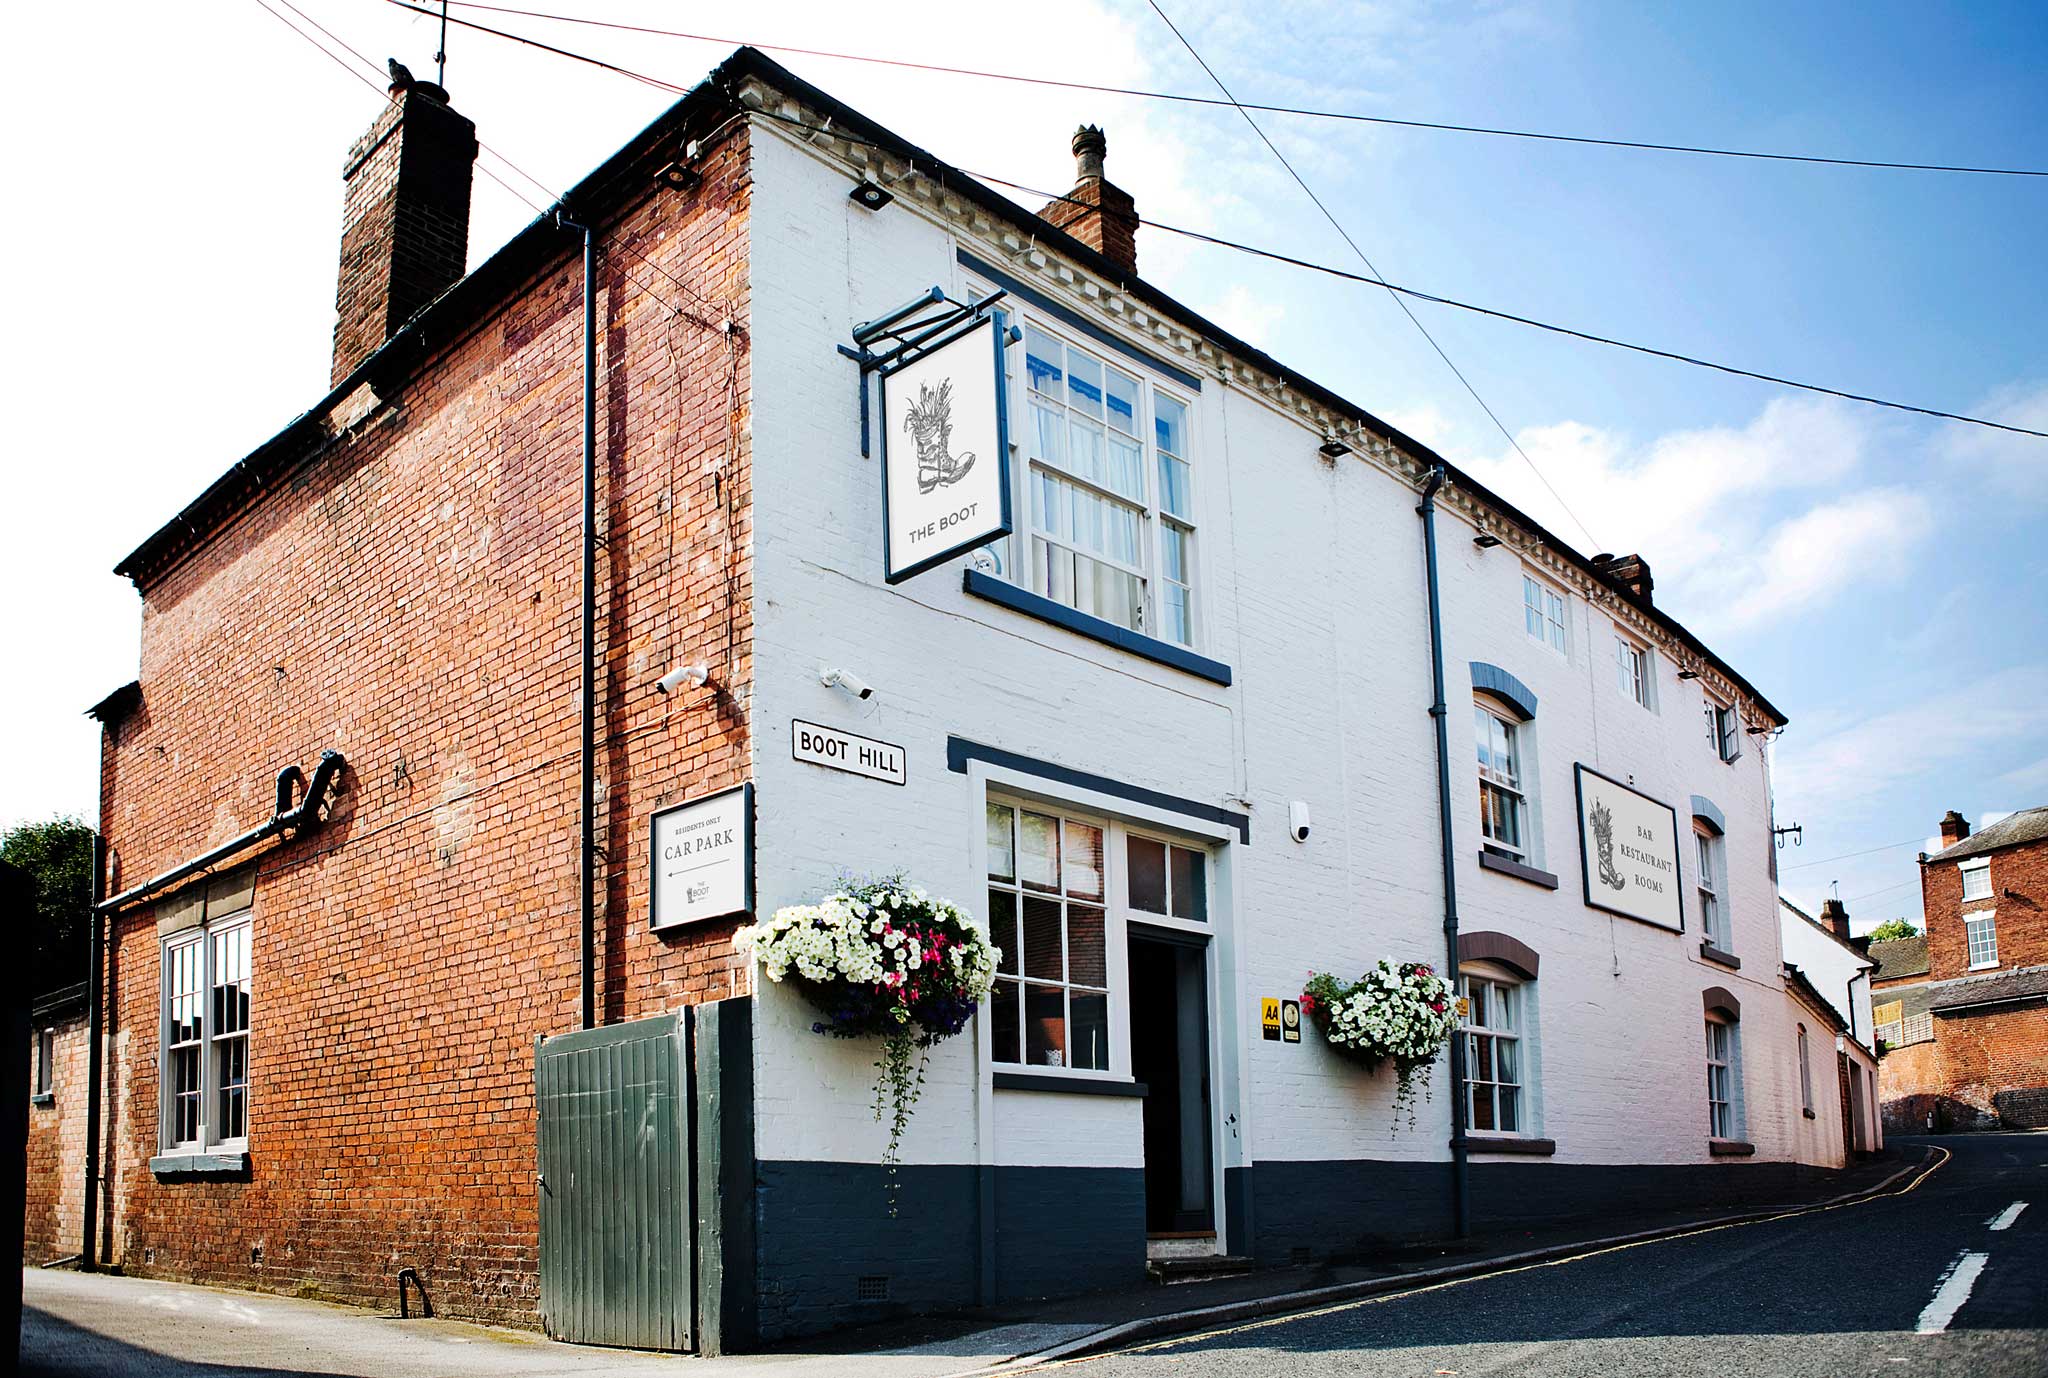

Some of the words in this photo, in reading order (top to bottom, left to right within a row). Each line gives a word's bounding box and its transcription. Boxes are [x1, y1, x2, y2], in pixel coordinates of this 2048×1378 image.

[909, 522, 935, 543] THE
[940, 502, 978, 531] BOOT
[801, 731, 848, 760] BOOT
[860, 746, 898, 773] HILL
[675, 821, 705, 835] RESIDENTS
[705, 816, 721, 827] ONLY
[1637, 826, 1654, 841] BAR
[664, 841, 692, 860] CAR
[696, 828, 734, 852] PARK
[1620, 843, 1673, 873] RESTAURANT
[693, 886, 710, 897] BOOT
[1634, 873, 1663, 894] ROOMS
[1265, 1004, 1279, 1021] AA
